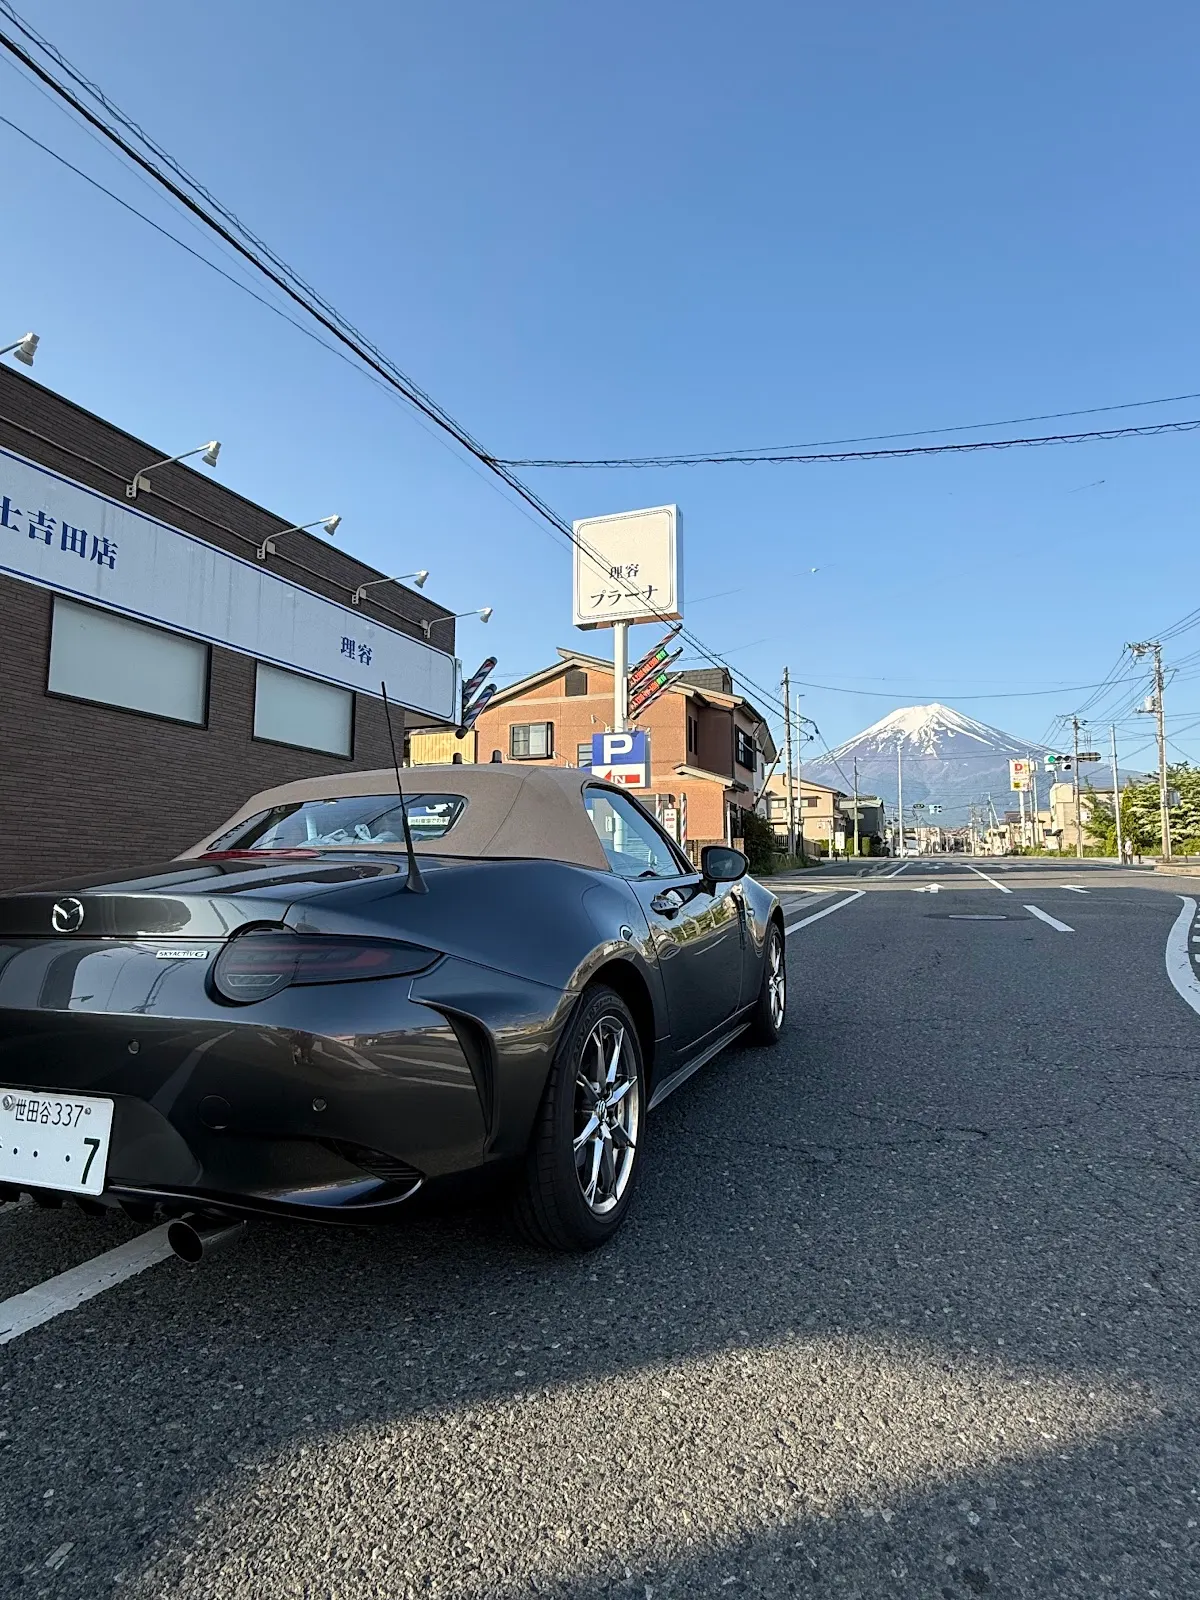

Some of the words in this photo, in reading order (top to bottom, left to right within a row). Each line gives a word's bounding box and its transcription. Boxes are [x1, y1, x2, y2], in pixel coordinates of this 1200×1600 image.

[610, 563, 639, 579] 理容
[590, 584, 659, 608] プラーナ
[340, 635, 373, 666] 理容
[603, 734, 633, 763] P
[611, 775, 626, 784] IN
